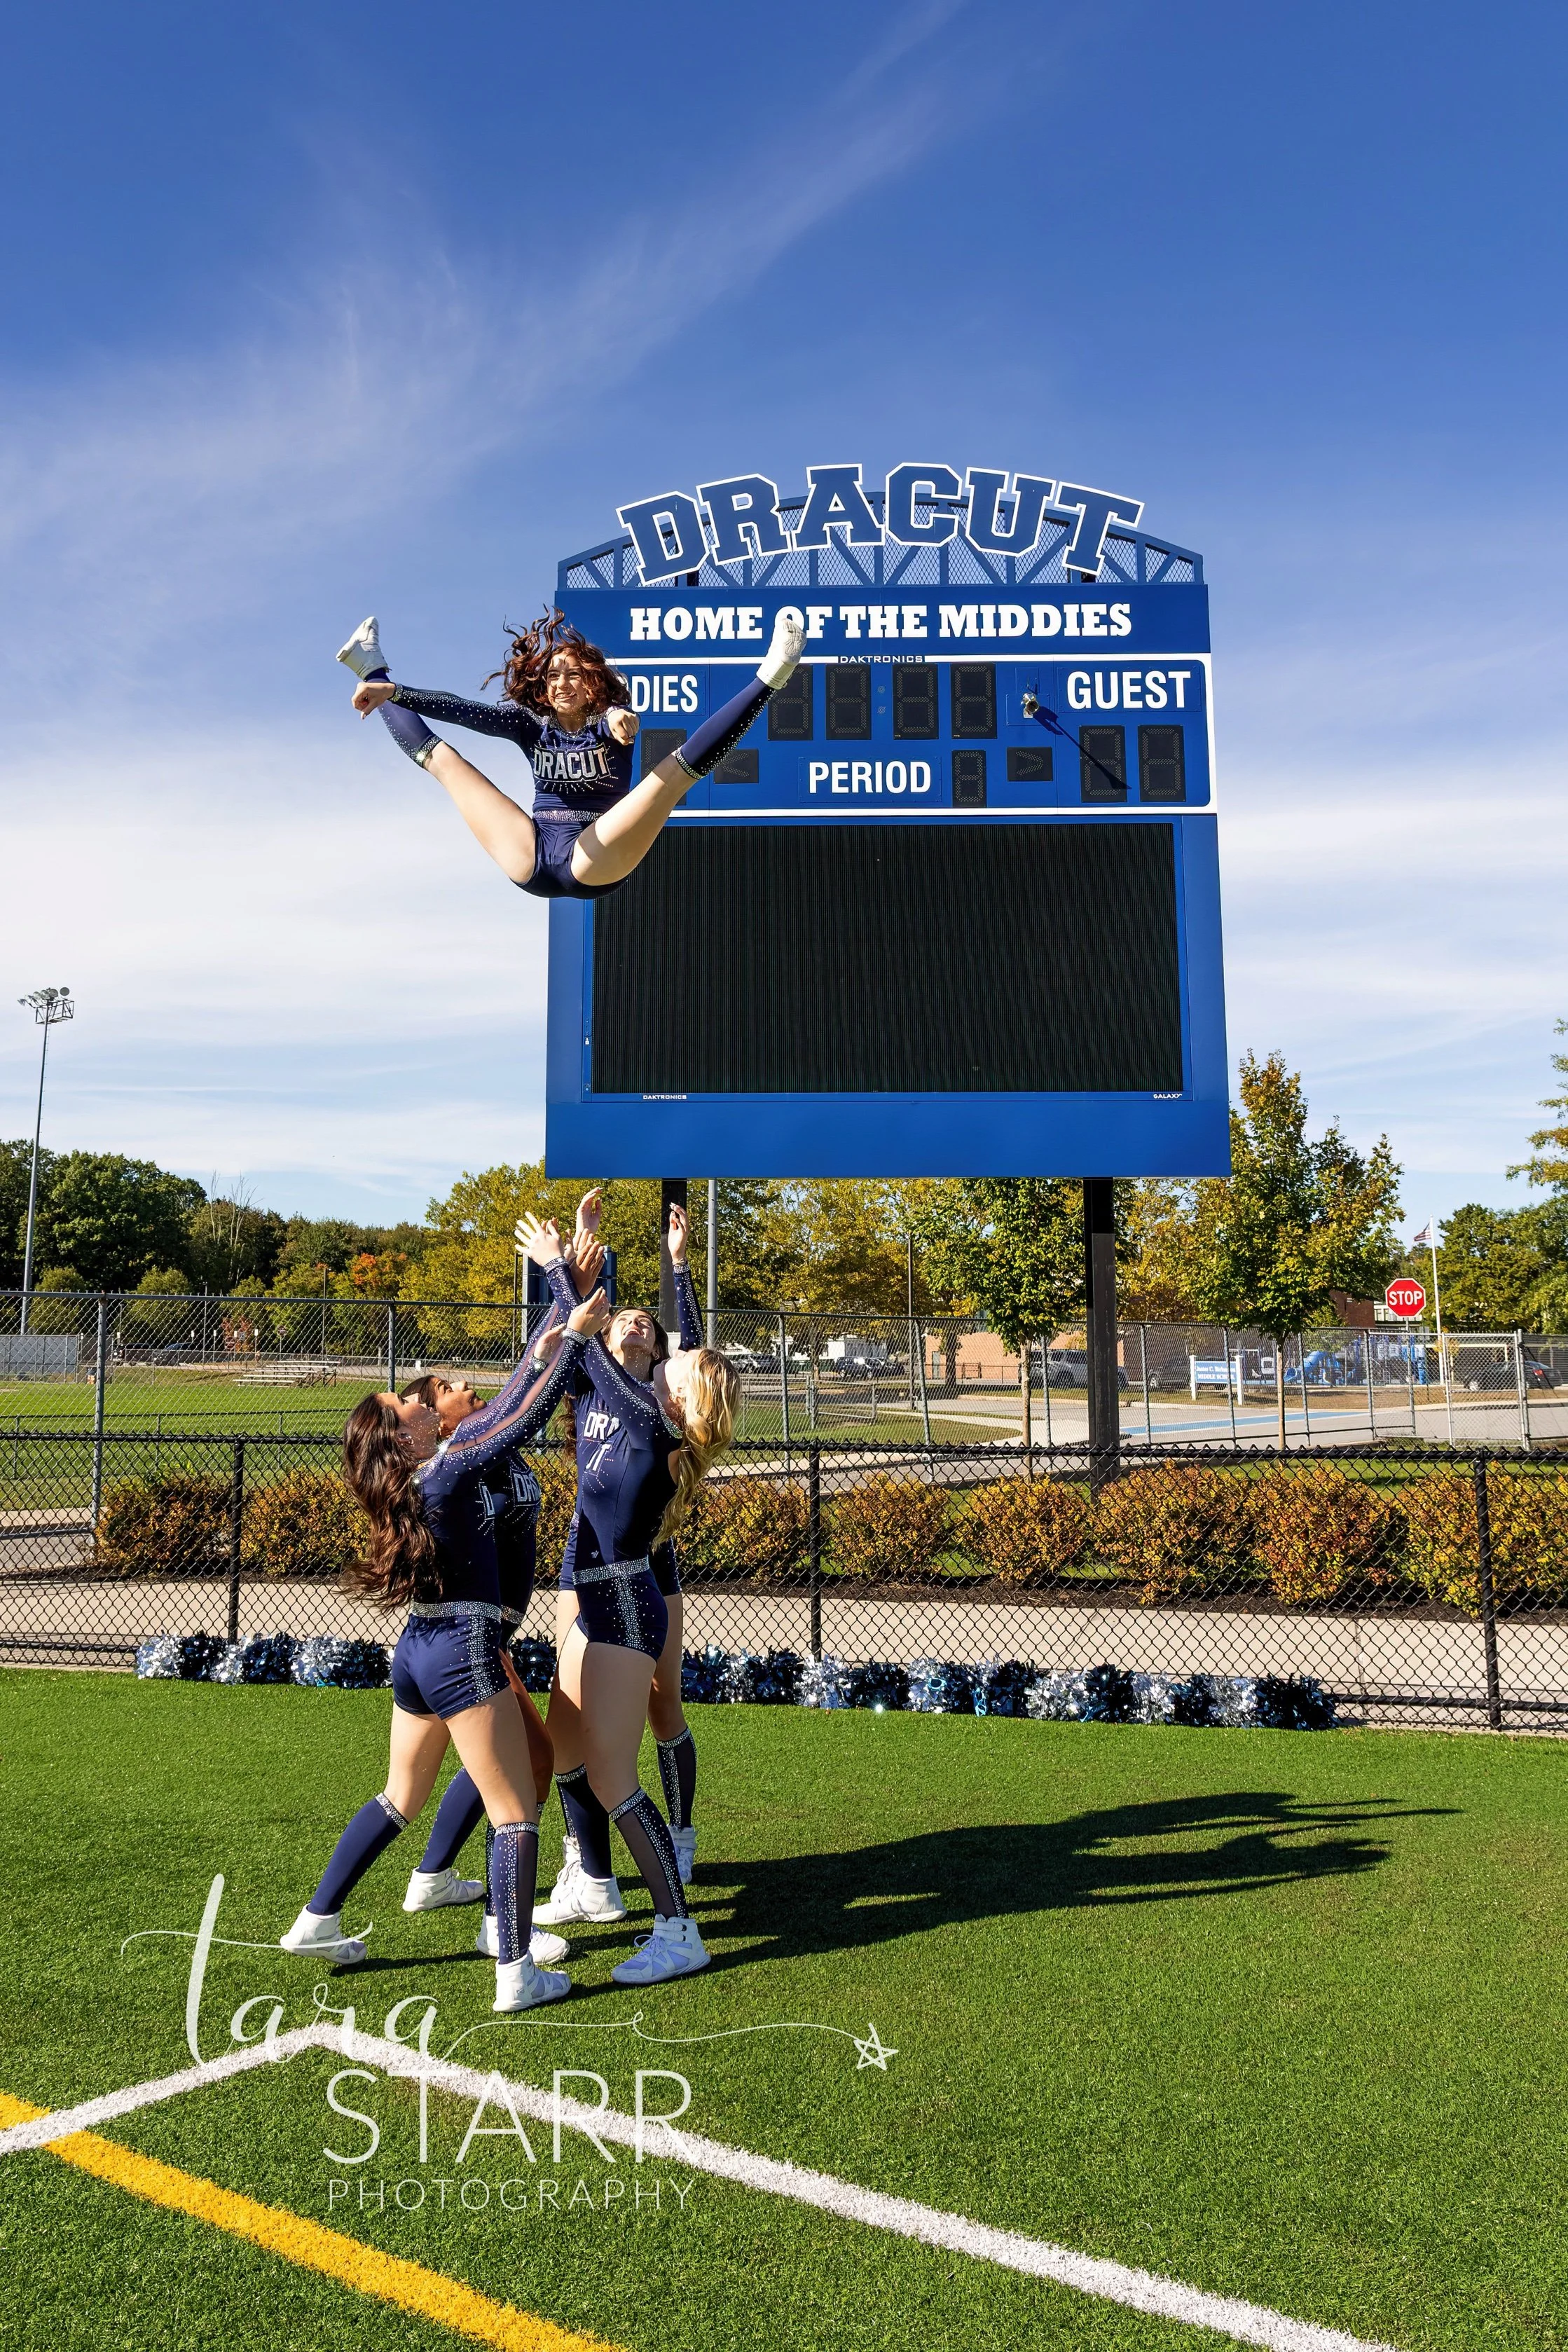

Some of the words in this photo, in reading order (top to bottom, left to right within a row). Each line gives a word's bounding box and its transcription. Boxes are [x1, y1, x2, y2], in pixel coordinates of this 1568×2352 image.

[615, 462, 1145, 587] DRACUT
[630, 607, 762, 640] HOME
[839, 605, 928, 638] THE
[939, 604, 1132, 638] MIDDIES
[840, 655, 923, 663] DAKTRONICS
[617, 674, 699, 713] DIES
[1067, 670, 1191, 710] GUEST
[534, 746, 607, 779] DRACUT
[809, 760, 931, 794] PERIOD
[1389, 1290, 1423, 1306] STOP
